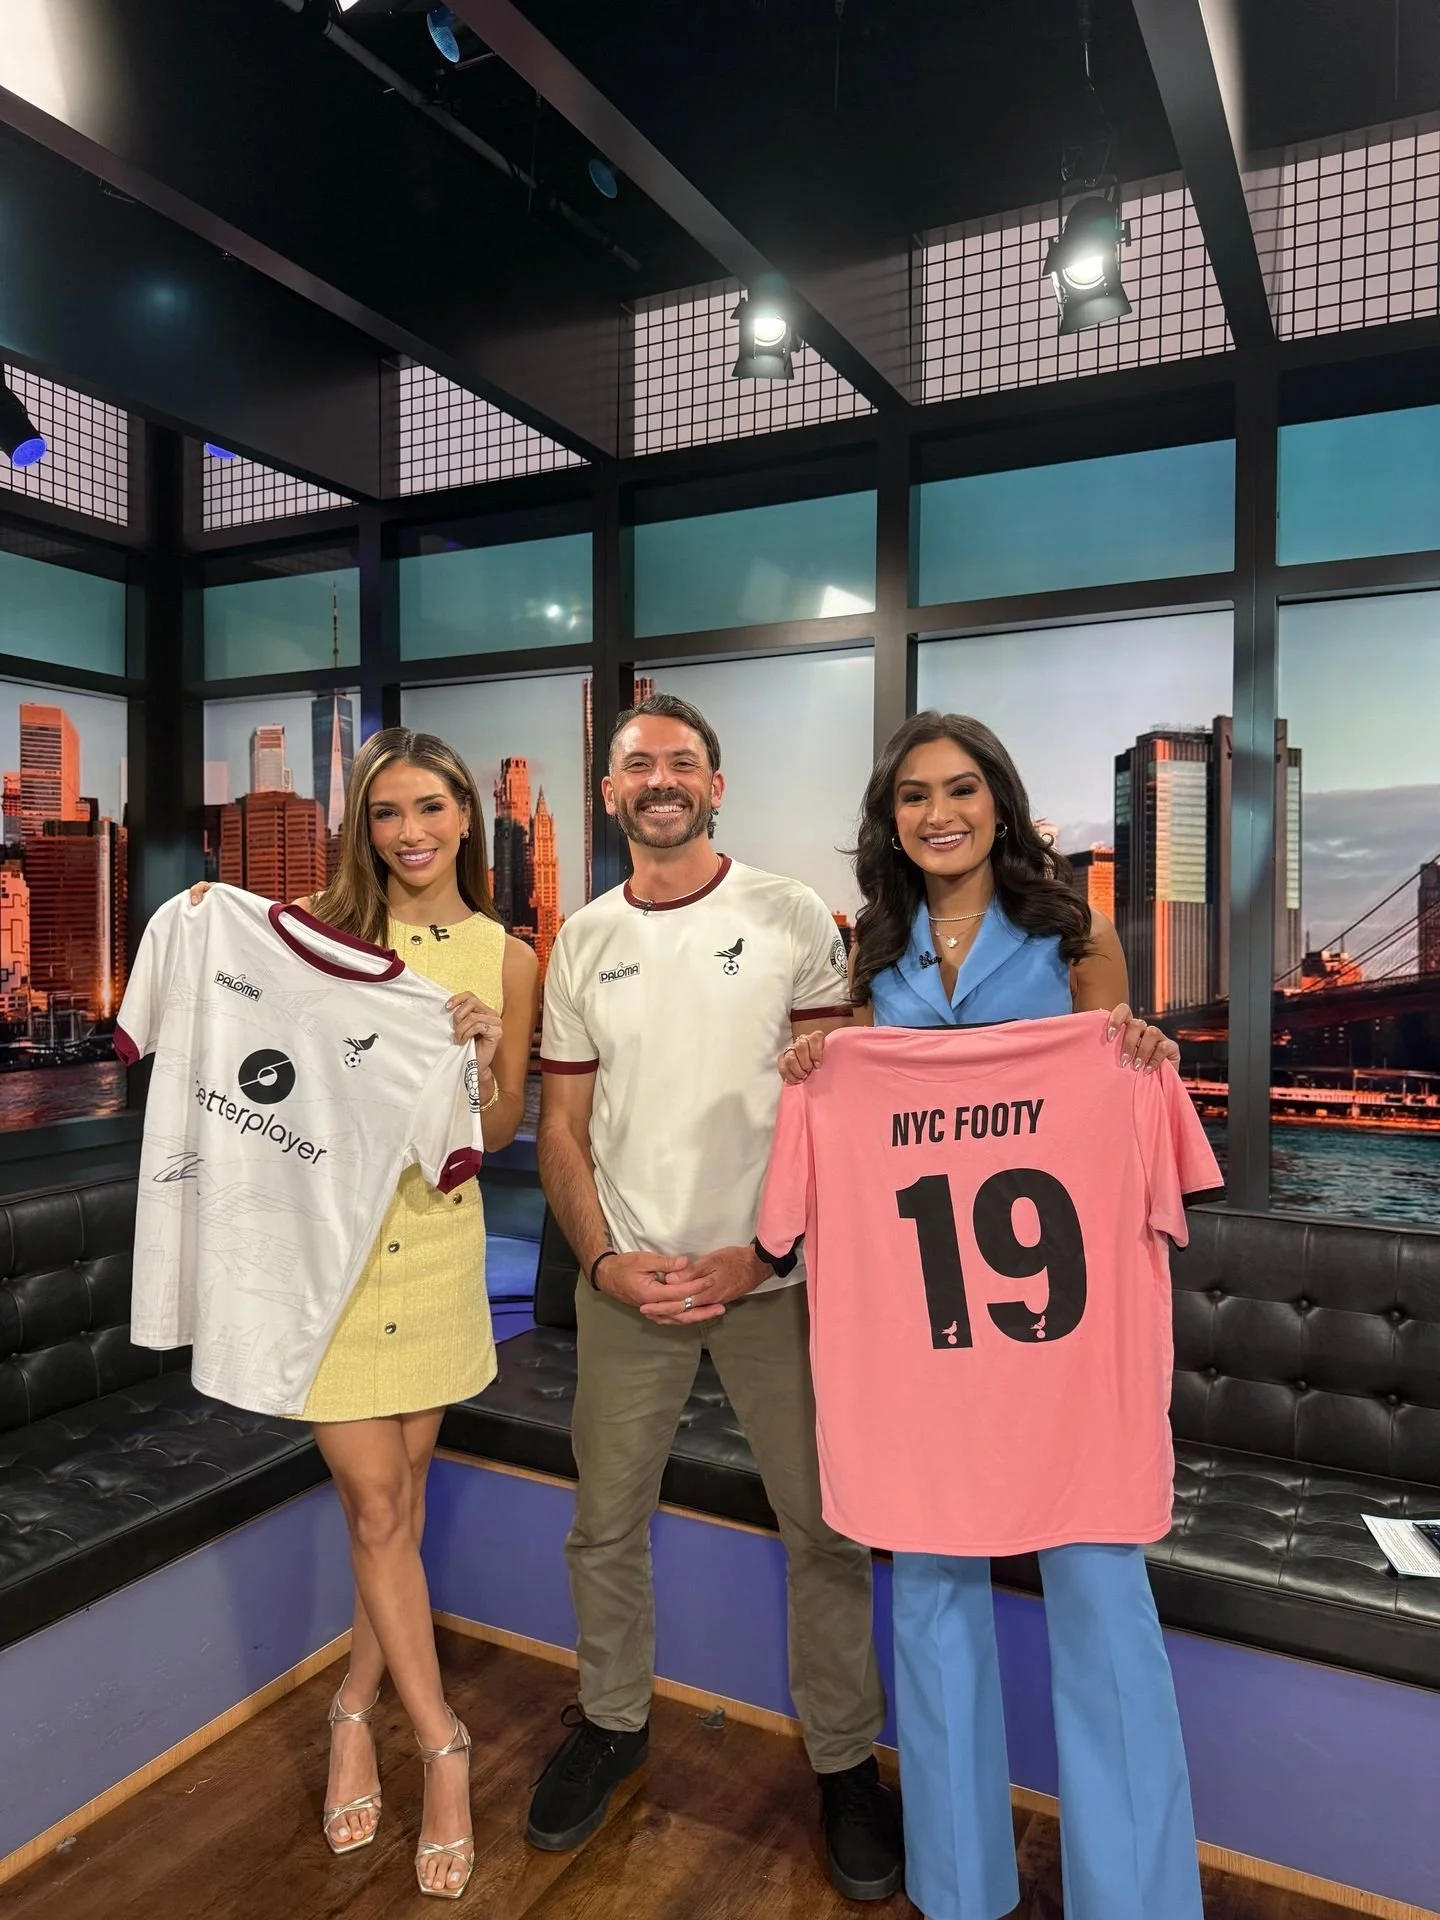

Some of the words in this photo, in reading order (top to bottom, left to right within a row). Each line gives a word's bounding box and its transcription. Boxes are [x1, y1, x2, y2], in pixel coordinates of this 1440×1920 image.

[216, 973, 260, 1000] PALOMA
[600, 965, 639, 981] PALOMA
[195, 1071, 327, 1165] etterplayer
[892, 1108, 945, 1147] NYC
[954, 1098, 1045, 1141] FOOTY
[895, 1167, 1087, 1350] 19
